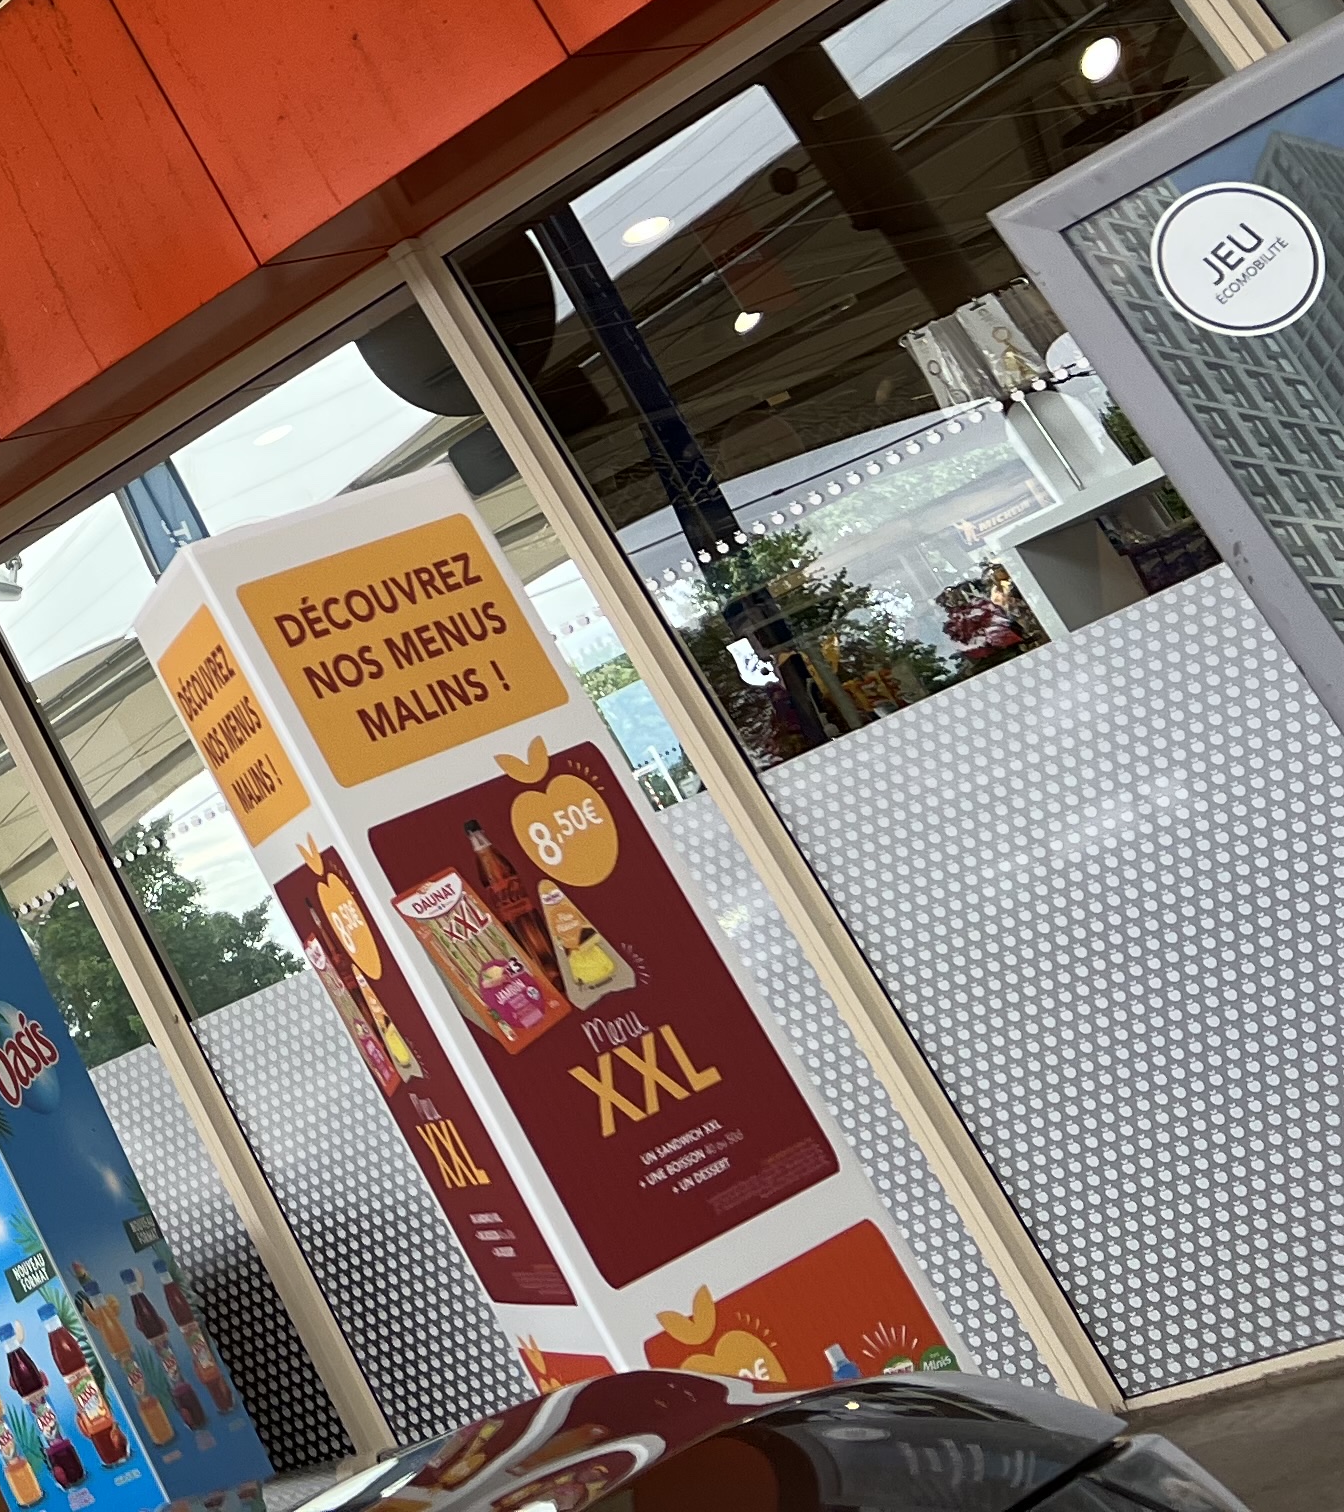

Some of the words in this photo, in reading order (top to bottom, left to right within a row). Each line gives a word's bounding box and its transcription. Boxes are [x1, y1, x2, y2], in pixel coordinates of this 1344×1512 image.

[1203, 223, 1264, 285] JEU
[1216, 236, 1289, 305] ÉCOMOBILITÉ
[274, 552, 483, 648] DÉCOUVREZ
[302, 645, 384, 699] NOS
[383, 601, 507, 670] MENUS
[177, 643, 236, 722] DÉCOUVREZ
[356, 667, 489, 742] MALINS
[490, 660, 511, 691] !
[201, 727, 230, 770] NOS
[217, 695, 262, 754] MENUS
[231, 758, 277, 814] MALINS
[264, 753, 283, 786] !
[528, 798, 604, 865] 8,50€
[412, 883, 456, 914] DAUNAT
[443, 891, 491, 944] XXL
[580, 1010, 650, 1054] Menu
[567, 1024, 722, 1138] XXL
[416, 1118, 491, 1188] XXL
[639, 1150, 658, 1165] UN
[654, 1127, 705, 1159] SANDWICH
[701, 1118, 723, 1134] XXL
[644, 1167, 668, 1185] UNE
[664, 1148, 706, 1176] BOISSON
[677, 1176, 696, 1191] UN
[692, 1156, 731, 1184] DESSERT
[11, 1252, 46, 1281] NOUVEAU
[19, 1267, 50, 1293] FORMAT
